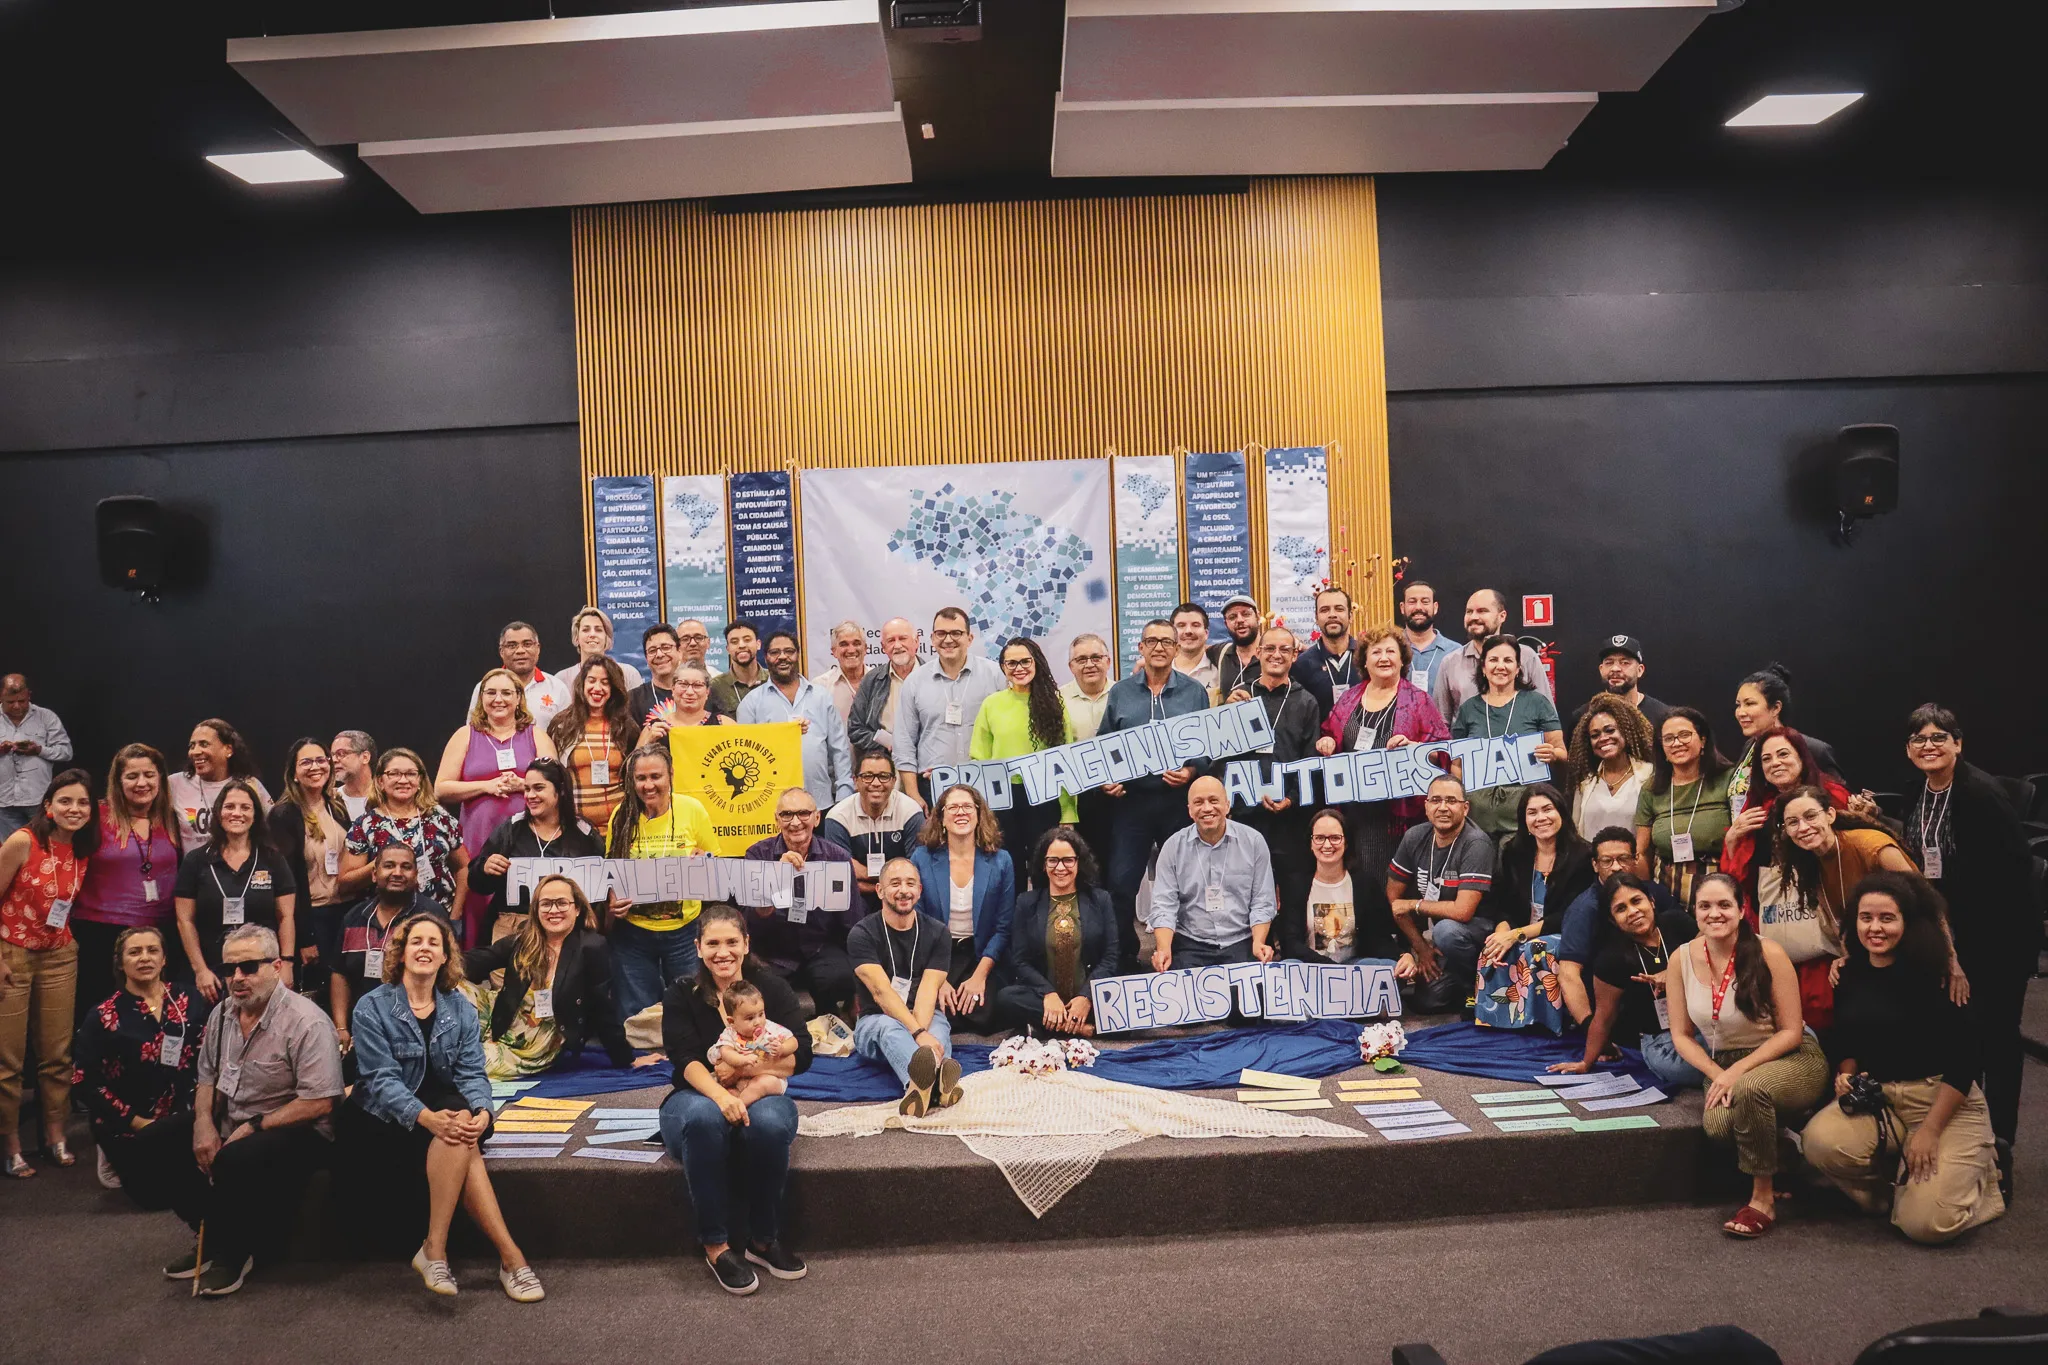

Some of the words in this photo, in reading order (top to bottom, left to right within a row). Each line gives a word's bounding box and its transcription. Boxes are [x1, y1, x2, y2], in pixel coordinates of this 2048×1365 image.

[1196, 480, 1234, 488] TRIBUTÁRIO
[1192, 492, 1234, 500] APROPRIADO
[608, 504, 646, 512] INSTÂNCIAS
[735, 500, 787, 508] ENVOLVIMENTO
[749, 511, 784, 519] CIDADANIA
[602, 525, 648, 534] PARTICIPAÇÃO
[606, 536, 630, 544] CIDADÃ
[1204, 534, 1232, 543] CRIAÇÃO
[601, 547, 651, 556] FORMULAÇÕES,
[743, 544, 771, 552] CRIANDO
[1192, 546, 1243, 554] APRIMORAMEN-
[745, 565, 784, 574] FAVORÁVEL
[602, 570, 618, 578] ÇÃO,
[1213, 578, 1243, 586] DOAÇÕES
[742, 587, 782, 595] AUTONOMIA
[740, 598, 791, 606] FORTALECIMEN-
[702, 740, 732, 767] LEVANTE
[734, 738, 776, 764] FEMINISTA
[703, 784, 727, 810] CONTRA
[729, 804, 734, 813] O
[1094, 963, 1401, 1031] RESISTÊNCIA
